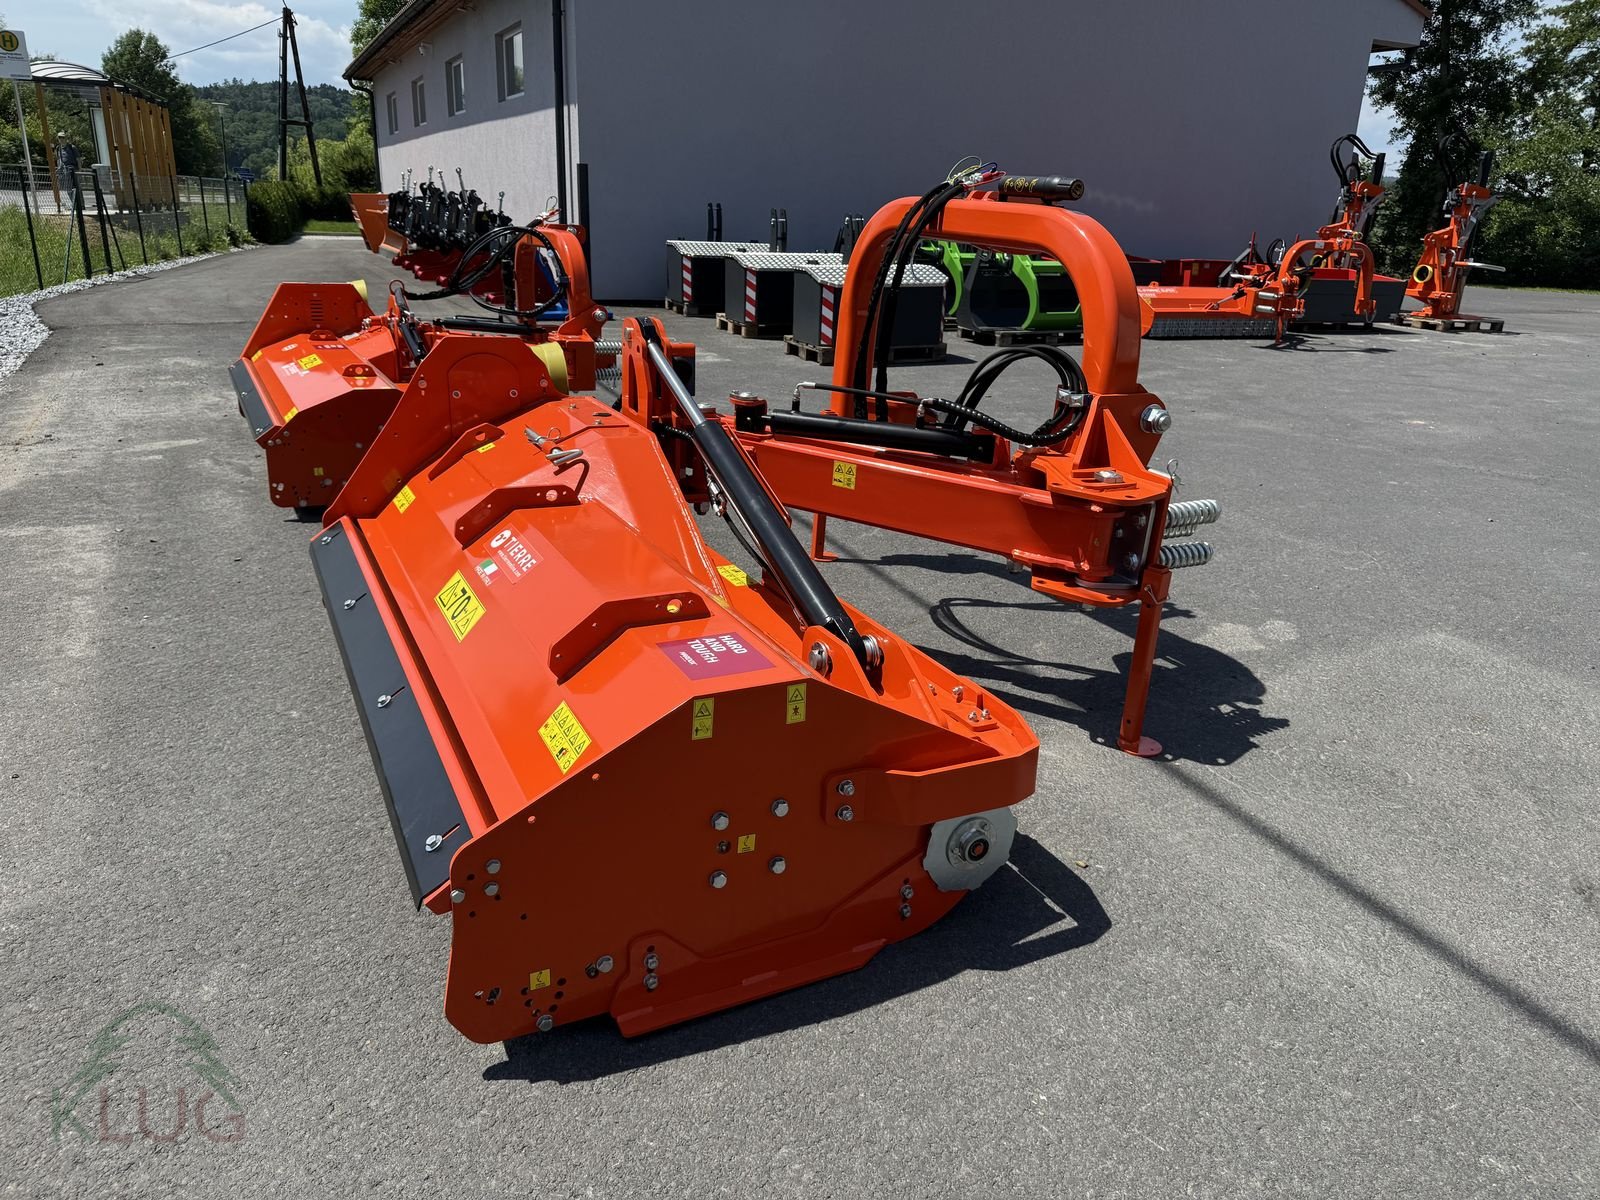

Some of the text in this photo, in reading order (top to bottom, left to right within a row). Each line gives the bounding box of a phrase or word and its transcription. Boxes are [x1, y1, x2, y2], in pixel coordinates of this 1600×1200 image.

[2, 34, 14, 48] H
[504, 536, 537, 572] TIERRE
[687, 639, 719, 663] TOUGH
[702, 638, 727, 652] AND
[718, 635, 748, 654] HARD
